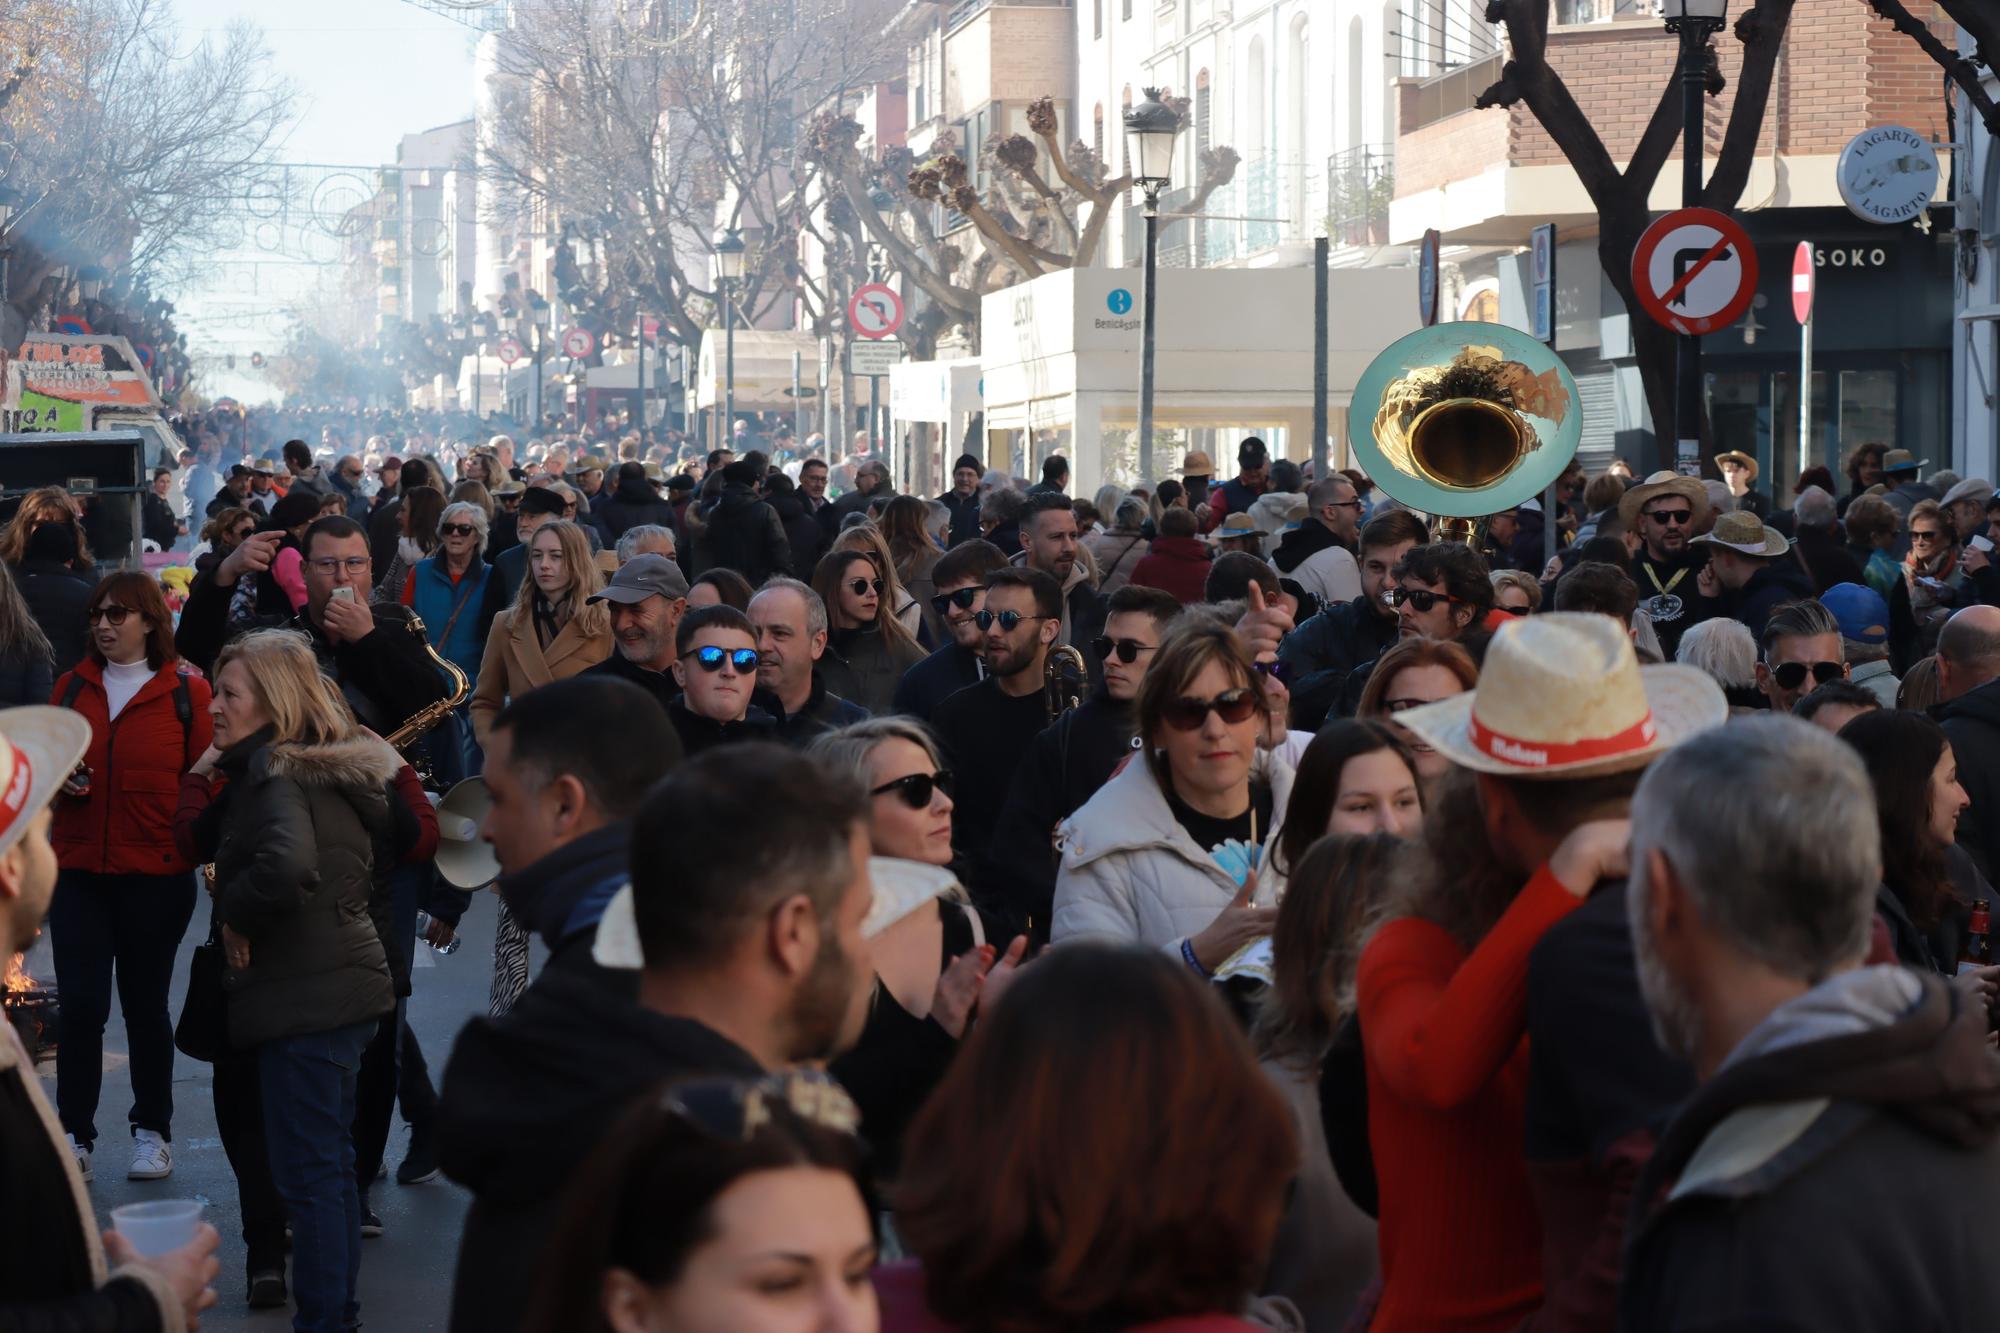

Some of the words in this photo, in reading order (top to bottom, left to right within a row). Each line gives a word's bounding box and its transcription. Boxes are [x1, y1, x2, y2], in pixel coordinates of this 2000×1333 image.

[1855, 130, 1921, 157] LAGARTO
[1861, 191, 1928, 218] LAGARTO
[1815, 248, 1886, 267] SOKO
